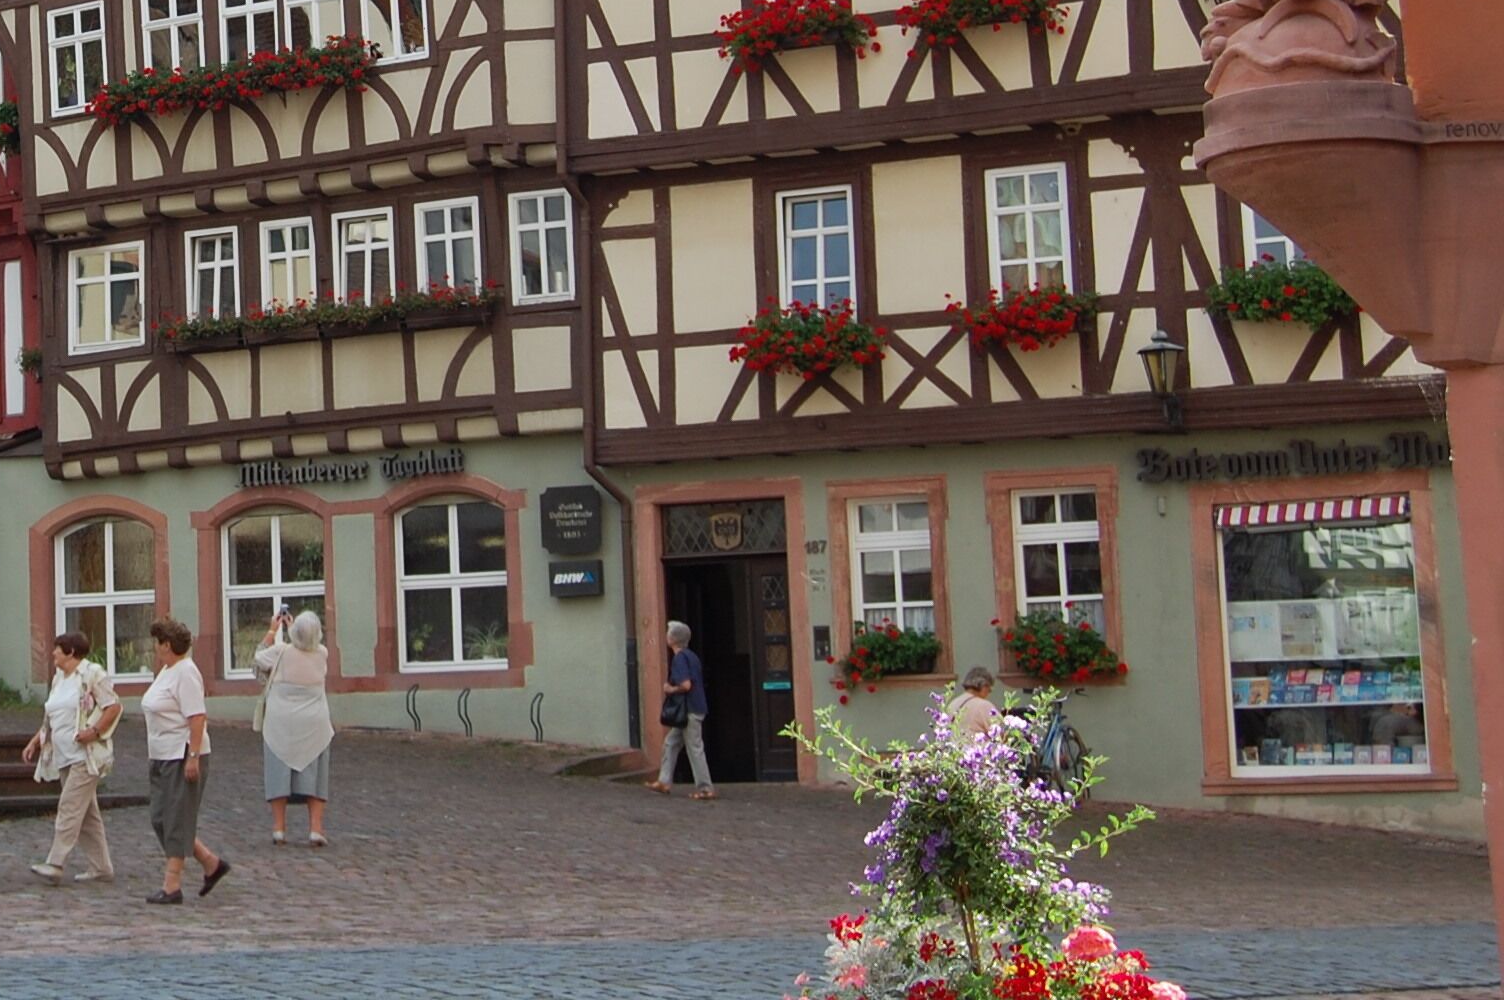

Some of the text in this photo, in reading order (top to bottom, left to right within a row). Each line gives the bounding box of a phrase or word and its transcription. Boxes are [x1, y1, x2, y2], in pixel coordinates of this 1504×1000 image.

[236, 447, 465, 488] Miltenberger Tagblatt
[1136, 447, 1217, 482] Bote
[1219, 450, 1290, 479] vom
[804, 540, 827, 554] 187
[553, 572, 585, 585] BHW
